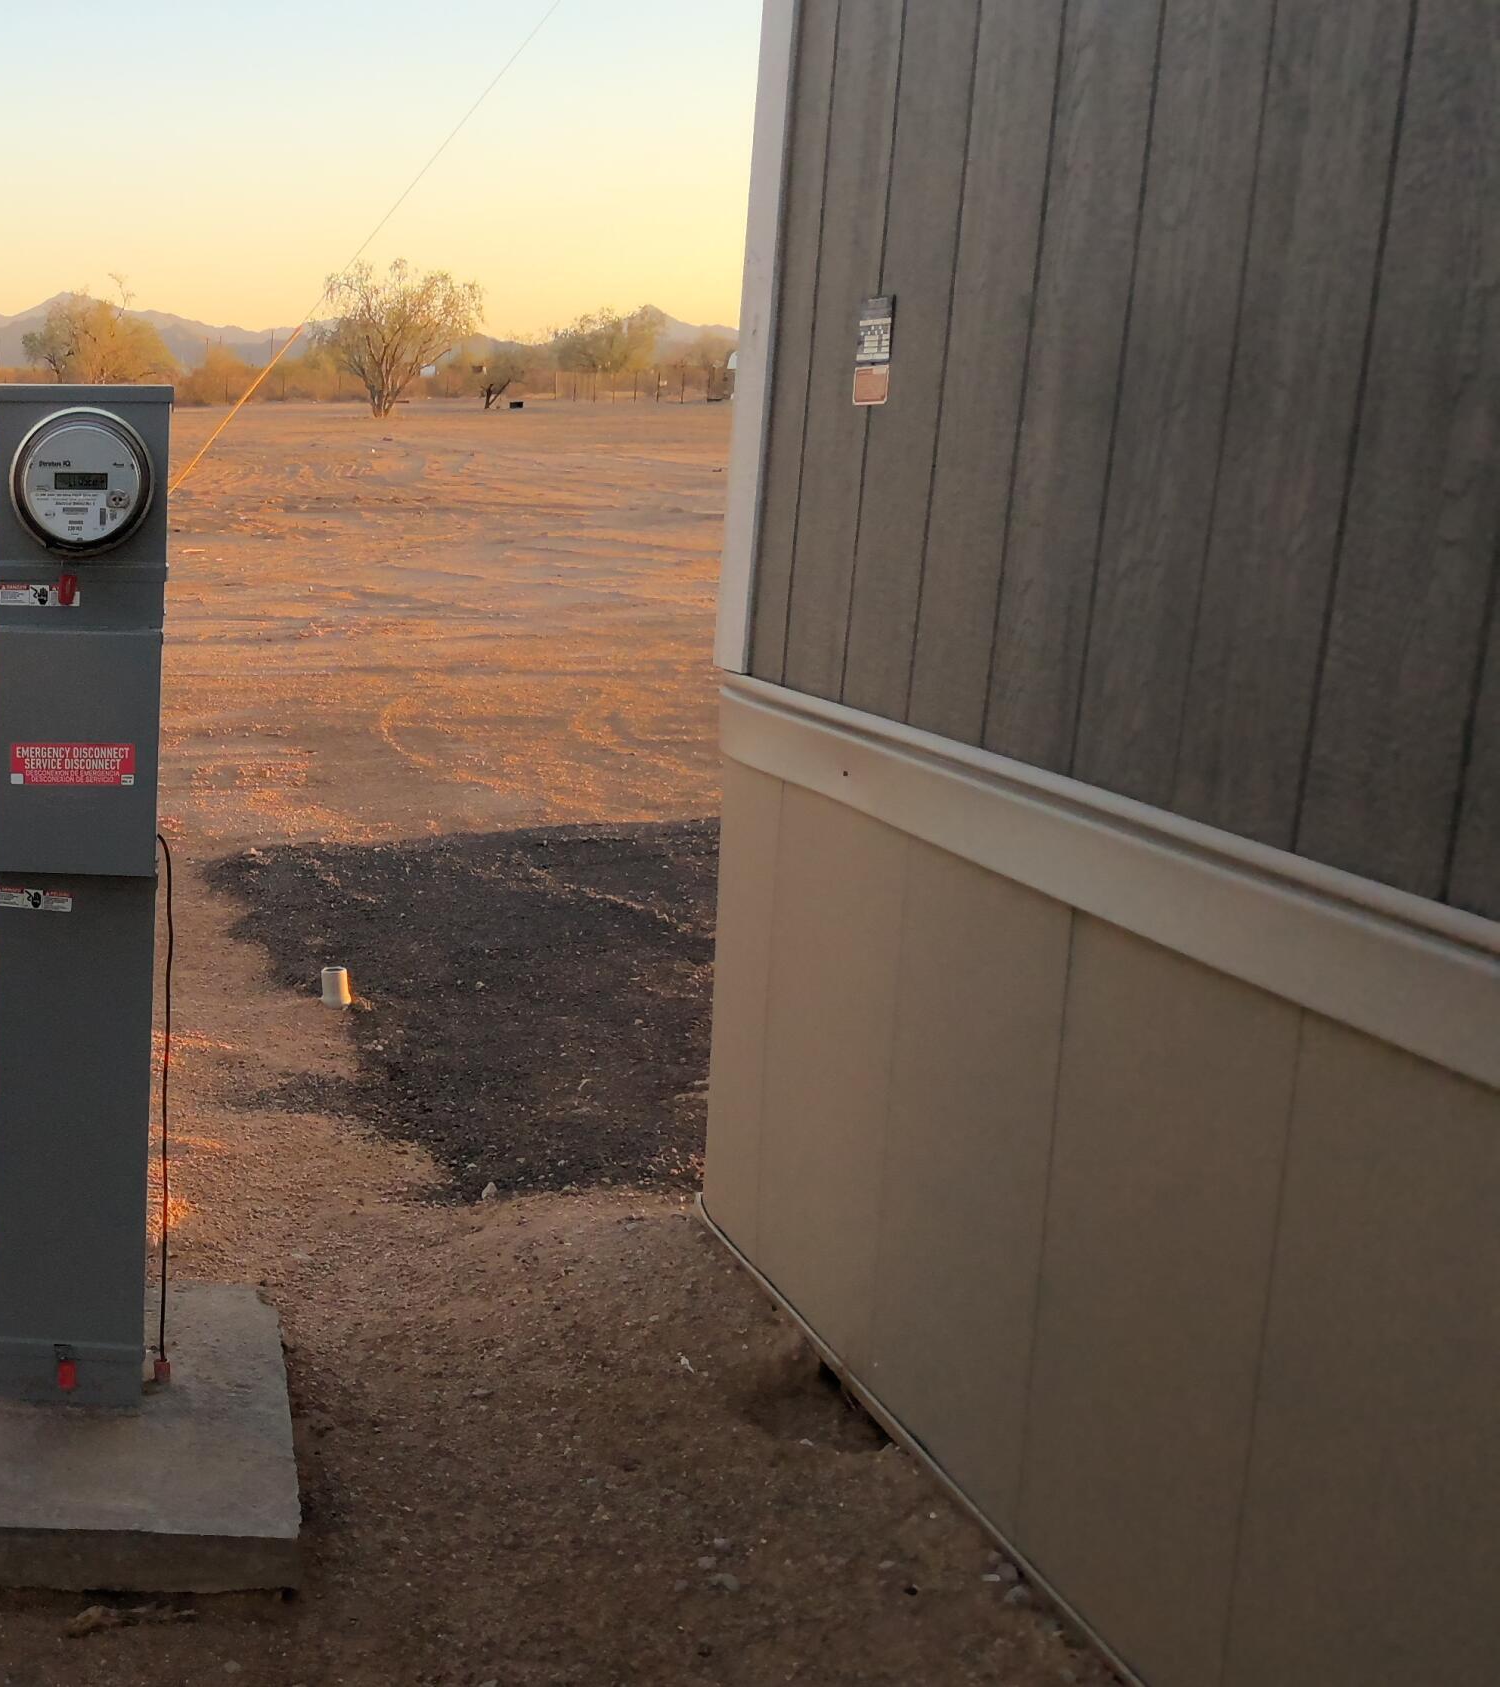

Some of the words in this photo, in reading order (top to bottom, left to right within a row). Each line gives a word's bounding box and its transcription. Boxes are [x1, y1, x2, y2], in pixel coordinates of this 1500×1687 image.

[16, 747, 70, 759] EMERGENCY
[73, 747, 130, 759] DISCONNECT
[24, 758, 62, 770] SERVICE
[64, 758, 121, 770] DISCONNECT
